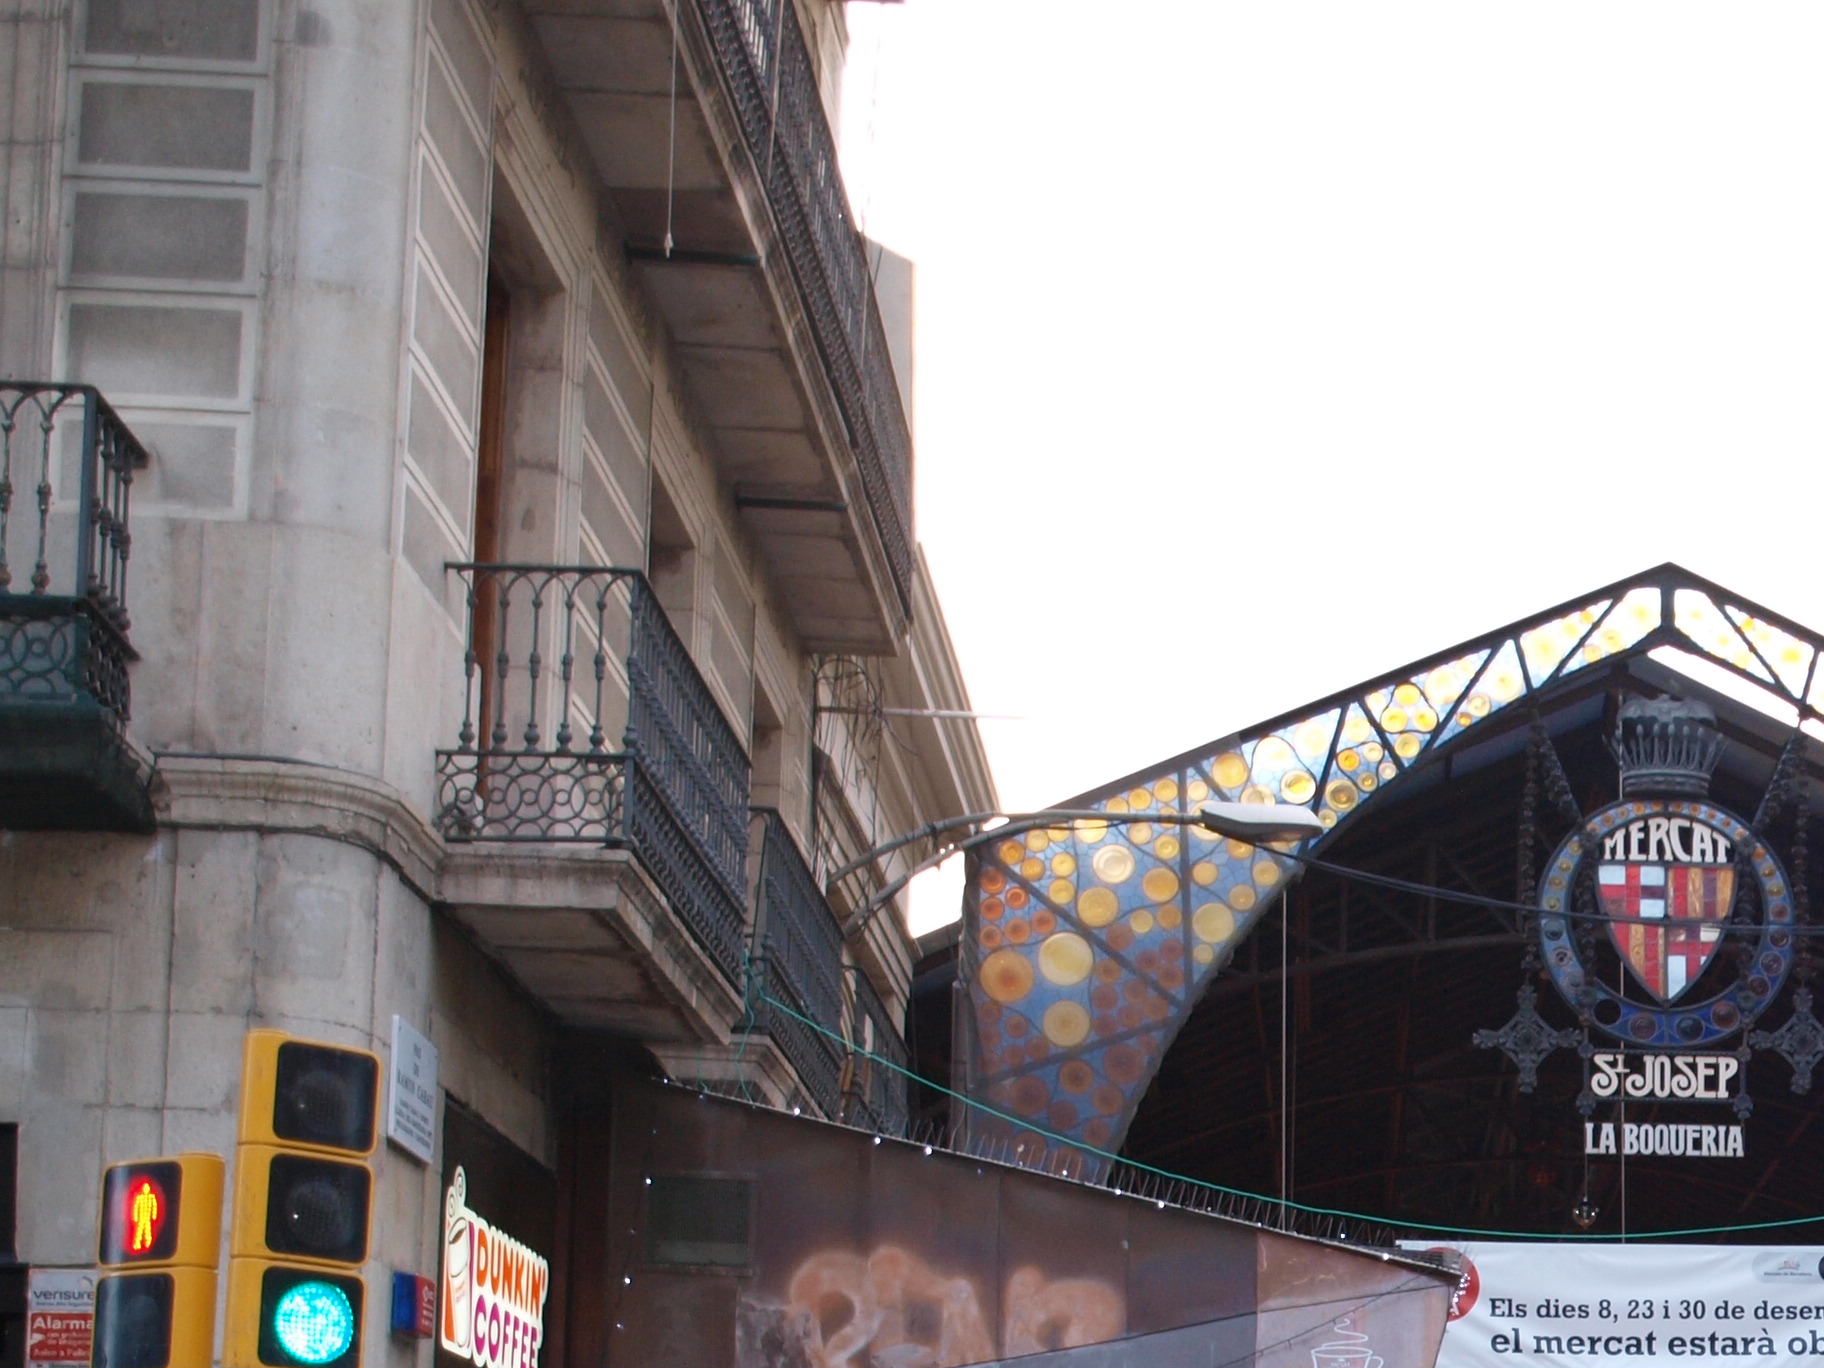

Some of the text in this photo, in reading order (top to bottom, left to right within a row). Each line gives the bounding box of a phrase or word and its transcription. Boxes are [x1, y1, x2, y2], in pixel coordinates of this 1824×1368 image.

[1604, 817, 1731, 863] MERCAT
[1625, 1055, 1738, 1099] JOSEP
[1585, 1122, 1745, 1158] LA BOQUERIA
[477, 1228, 546, 1319] DUNKIN'
[32, 1316, 94, 1330] Alarma
[1489, 1298, 1527, 1319] Els
[1536, 1299, 1589, 1319] dies
[1599, 1299, 1618, 1323] 8,
[1627, 1299, 1654, 1320] 23
[1663, 1299, 1671, 1320] i
[1679, 1300, 1705, 1320] 30
[1714, 1300, 1745, 1320] de
[1491, 1327, 1523, 1354] el
[1533, 1330, 1657, 1356] mercat
[1668, 1328, 1777, 1356] estarà
